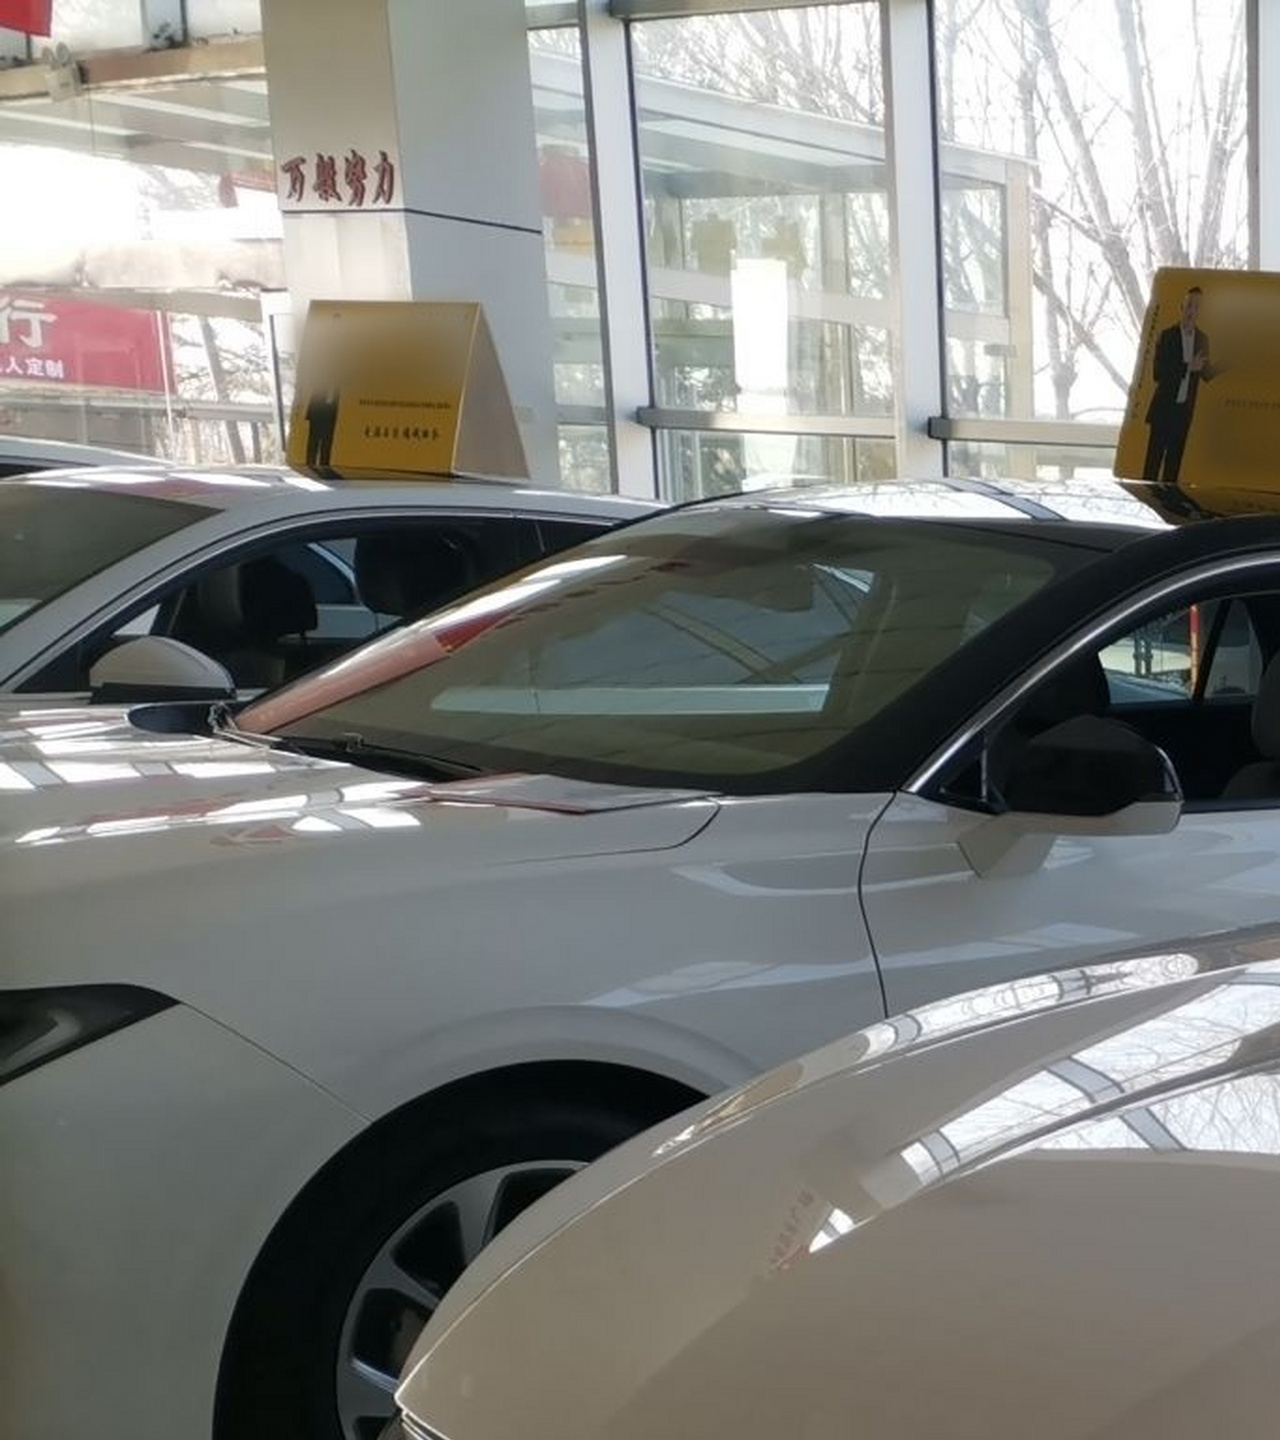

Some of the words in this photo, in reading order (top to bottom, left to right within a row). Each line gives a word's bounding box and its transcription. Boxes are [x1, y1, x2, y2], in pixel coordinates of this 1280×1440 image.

[0, 296, 59, 348] 行
[0, 355, 65, 379] 人定制
